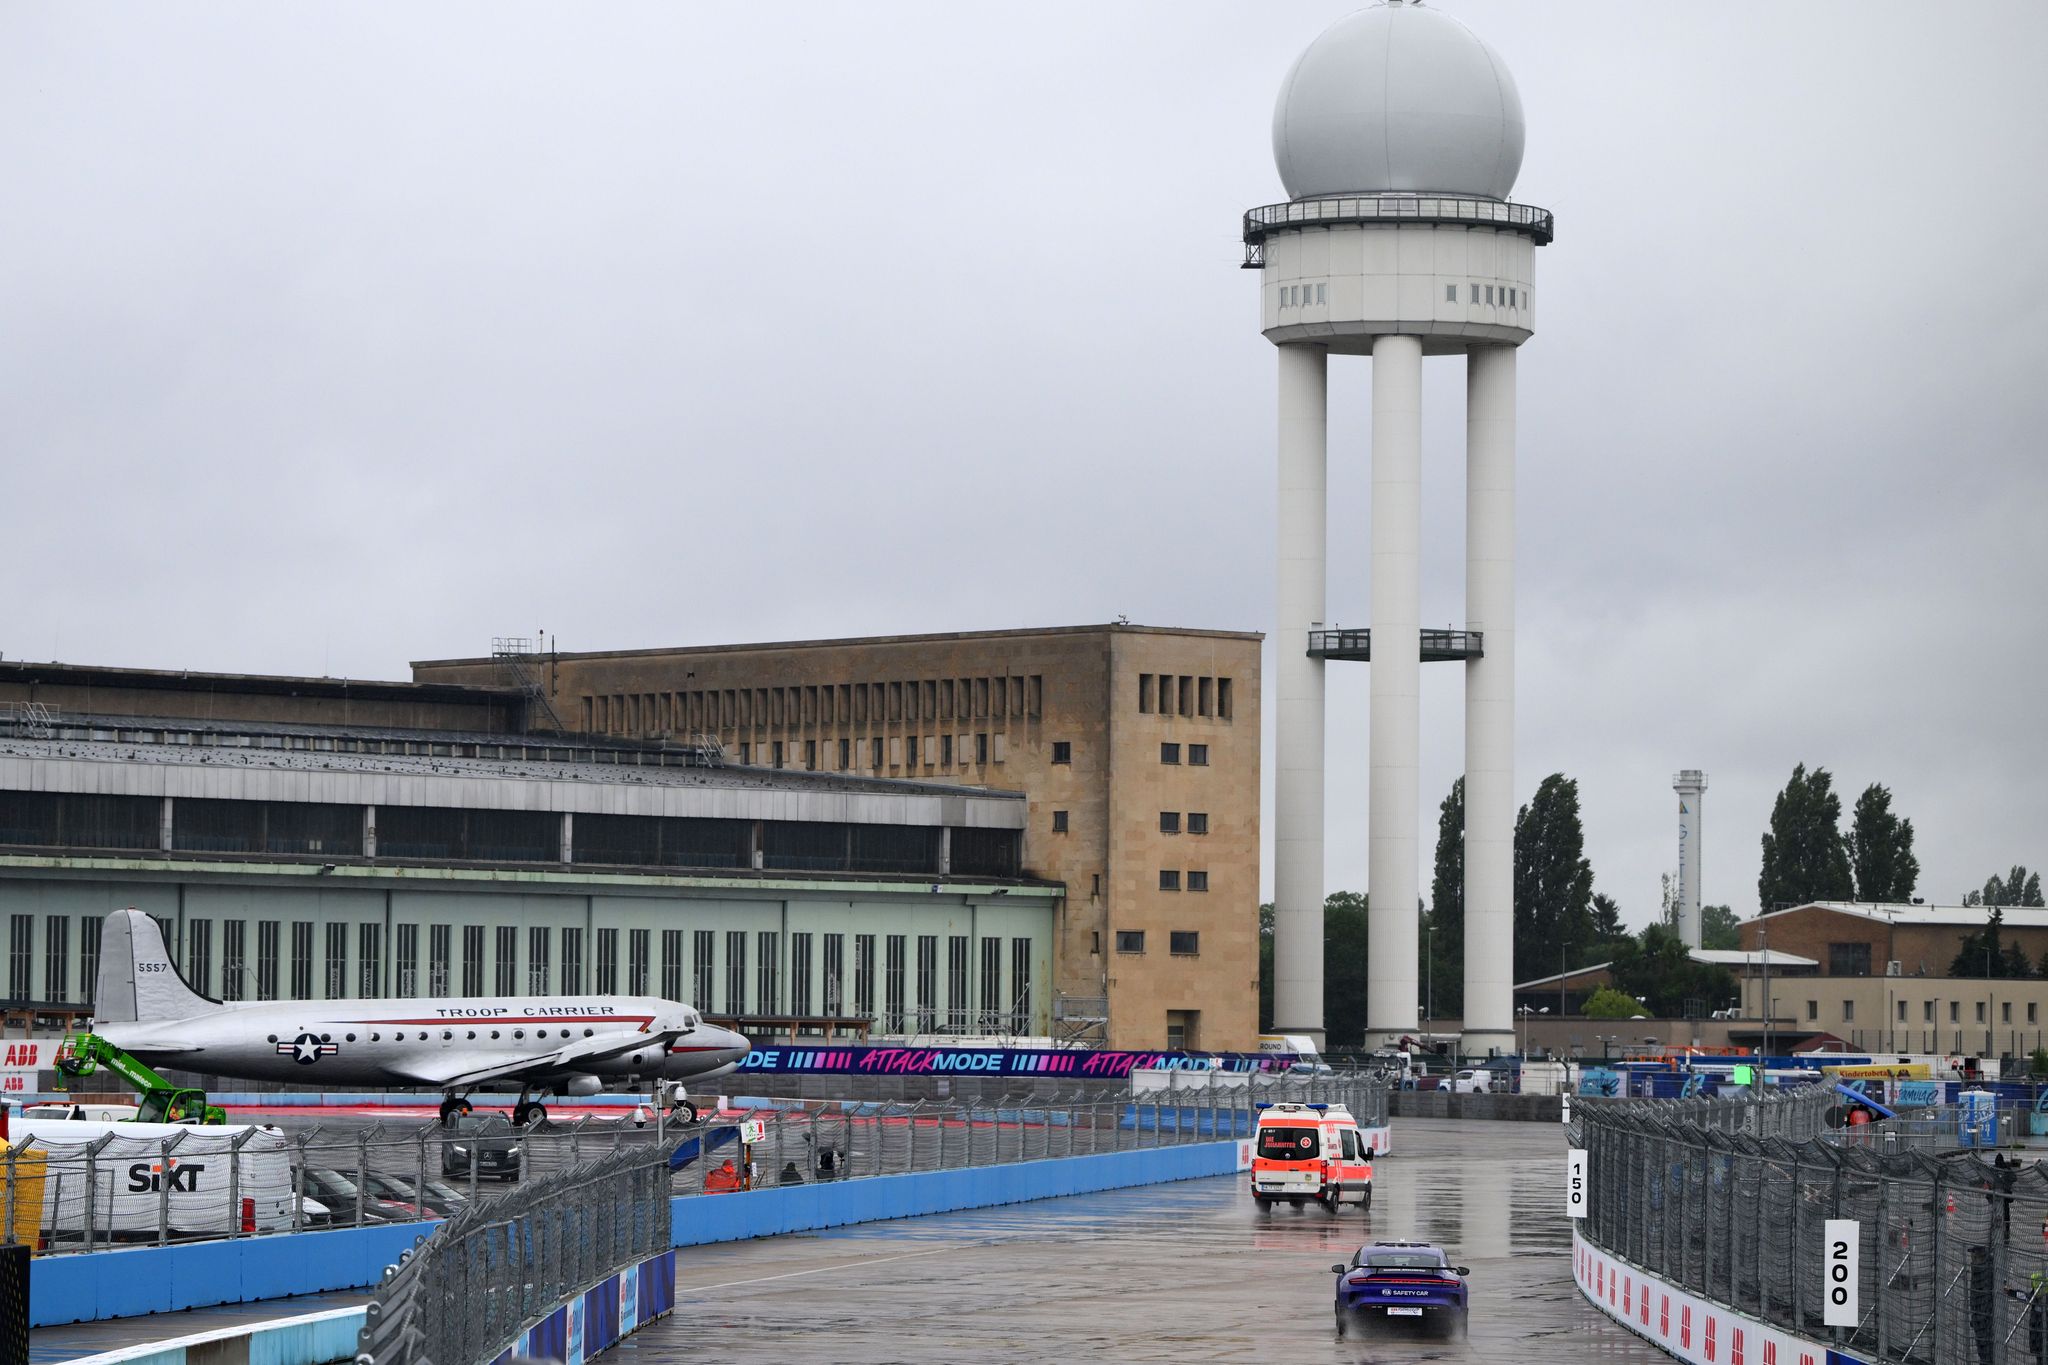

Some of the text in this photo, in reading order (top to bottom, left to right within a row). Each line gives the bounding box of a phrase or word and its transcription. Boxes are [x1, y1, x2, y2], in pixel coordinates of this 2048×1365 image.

[138, 963, 167, 972] 5557
[436, 1006, 615, 1018] TROOP CARRIER
[4, 1044, 38, 1066] ABB
[4, 1077, 23, 1091] ABB
[1571, 1163, 1582, 1204] 150
[1831, 1241, 1849, 1305] 200
